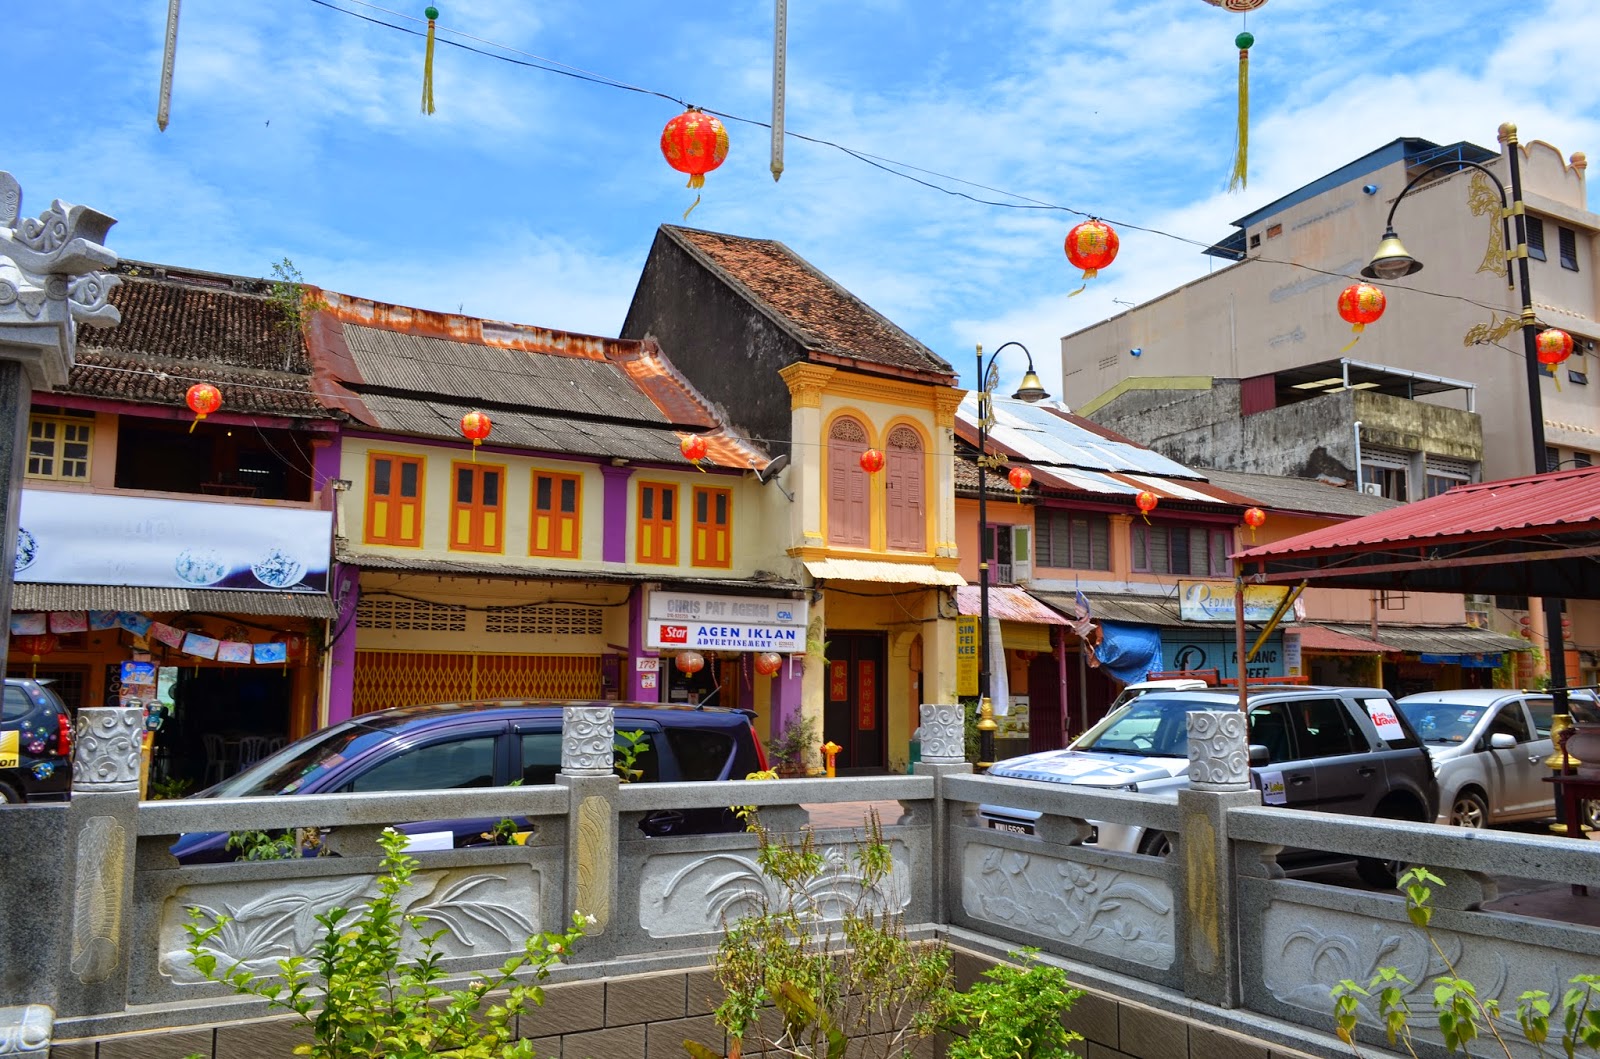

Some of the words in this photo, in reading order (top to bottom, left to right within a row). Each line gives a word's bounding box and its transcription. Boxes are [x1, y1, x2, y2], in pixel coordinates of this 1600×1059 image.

[667, 599, 701, 614] CHRIS
[705, 601, 726, 616] PAT
[731, 602, 770, 618] AGENSI
[665, 626, 688, 639] Star
[697, 626, 741, 638] AGEN
[748, 628, 796, 640] IKLAN
[958, 626, 975, 635] SIN
[697, 638, 773, 648] ADVERTISEMENT
[959, 636, 974, 645] FEI
[958, 645, 976, 655] KEE
[638, 660, 657, 669] 173
[1371, 713, 1398, 727] travel
[1026, 774, 1063, 782] ROVER
